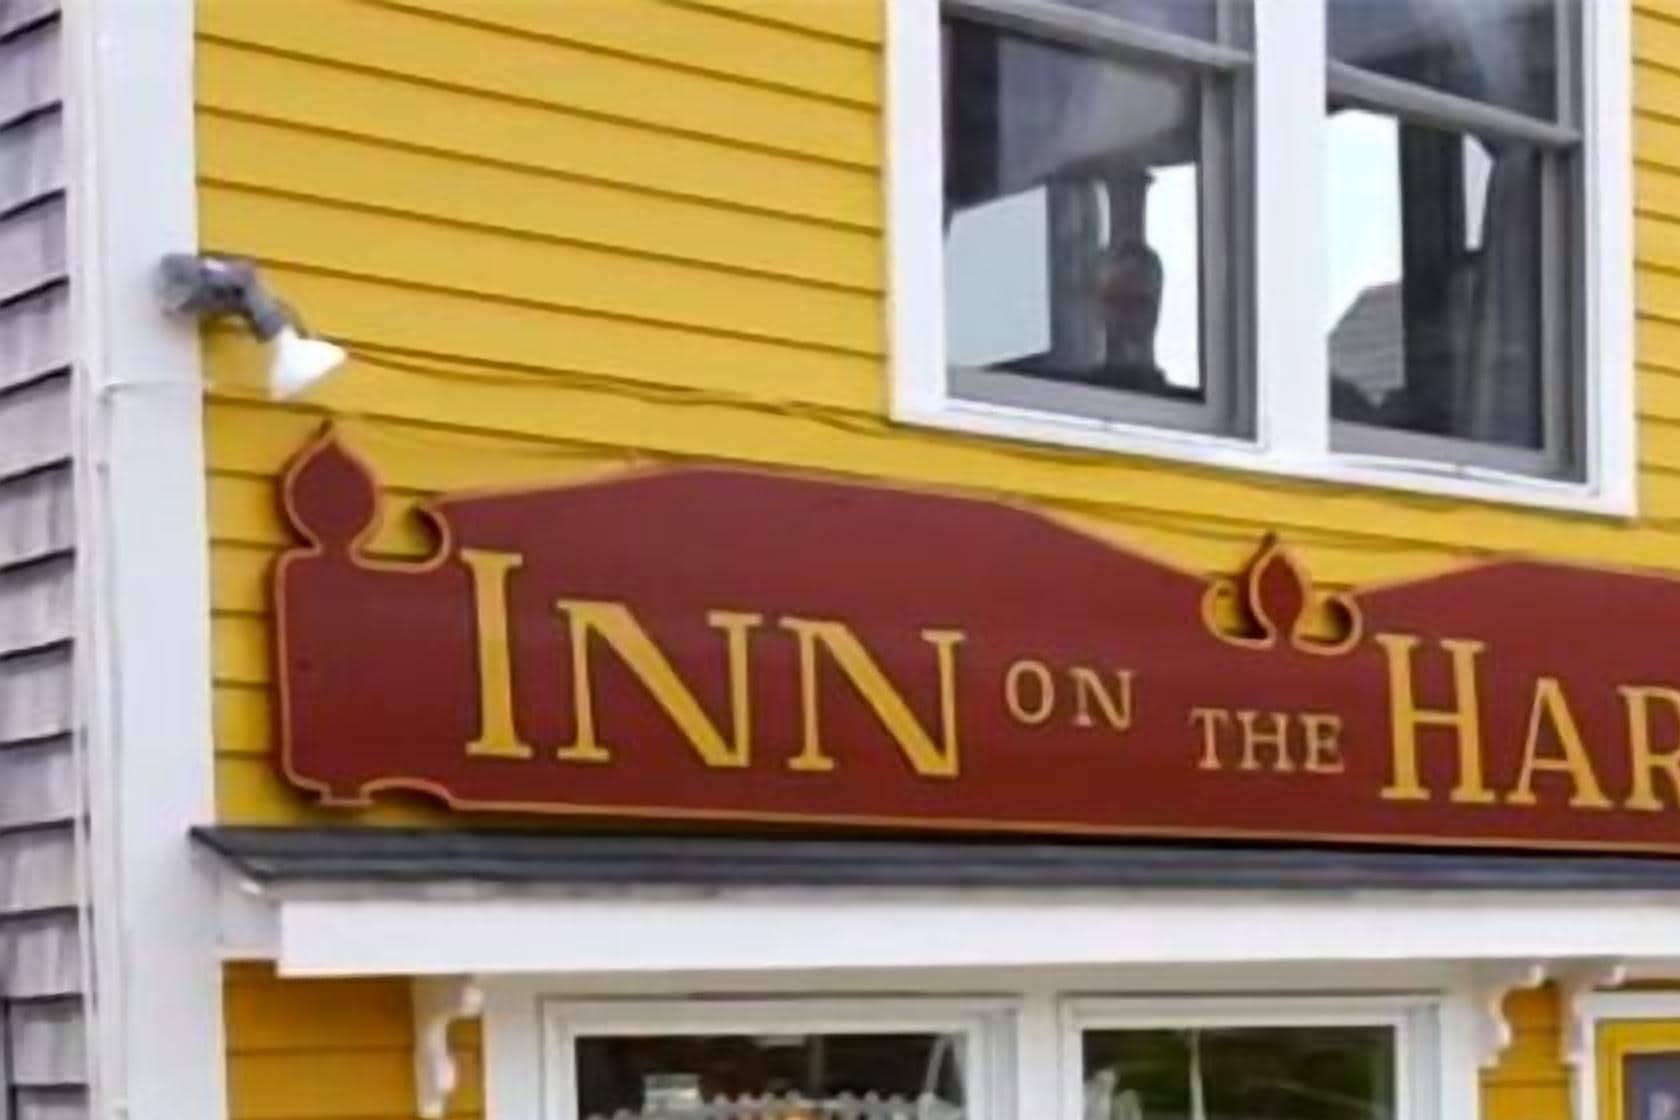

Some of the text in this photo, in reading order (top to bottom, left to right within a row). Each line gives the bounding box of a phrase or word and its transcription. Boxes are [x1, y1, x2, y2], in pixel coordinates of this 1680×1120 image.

[458, 546, 968, 778] INN
[1004, 659, 1134, 730] ON
[1189, 706, 1345, 774] THE
